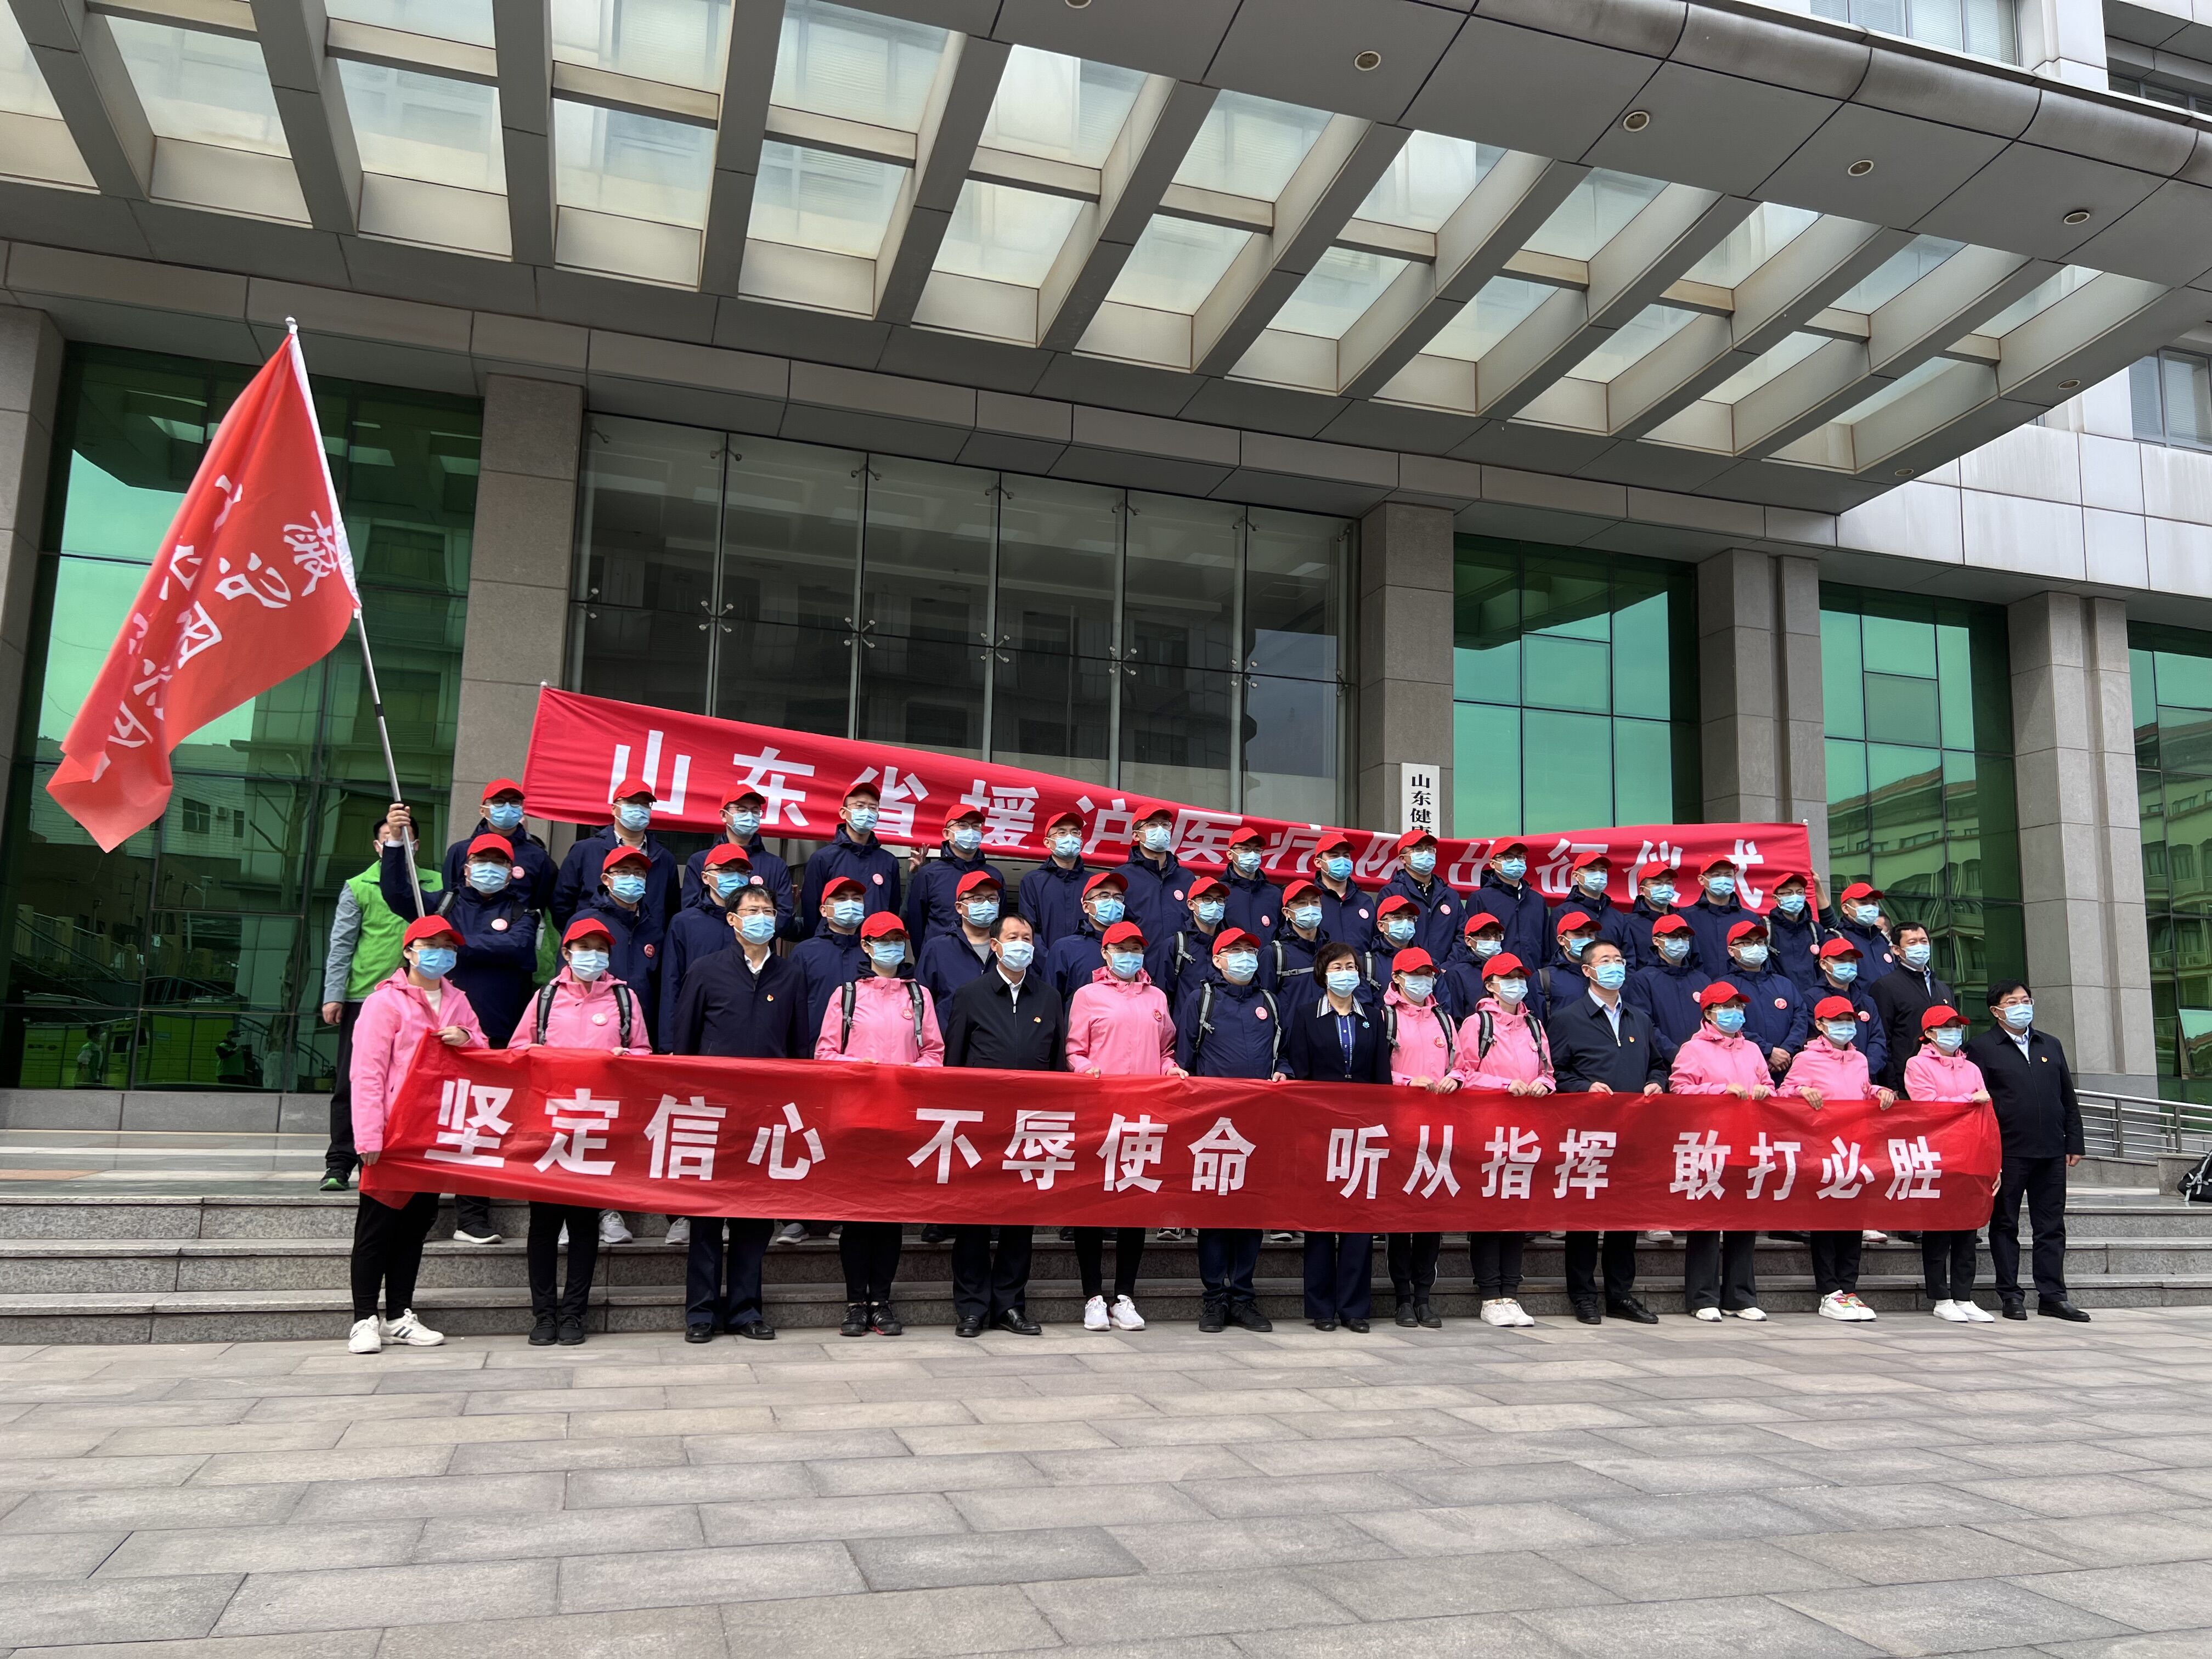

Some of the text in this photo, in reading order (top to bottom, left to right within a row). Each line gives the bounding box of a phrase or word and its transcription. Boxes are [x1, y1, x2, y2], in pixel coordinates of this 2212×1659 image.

[424, 1077, 1943, 1201] 坚定信心 不辱使命 听从指挥 敢打必胜
